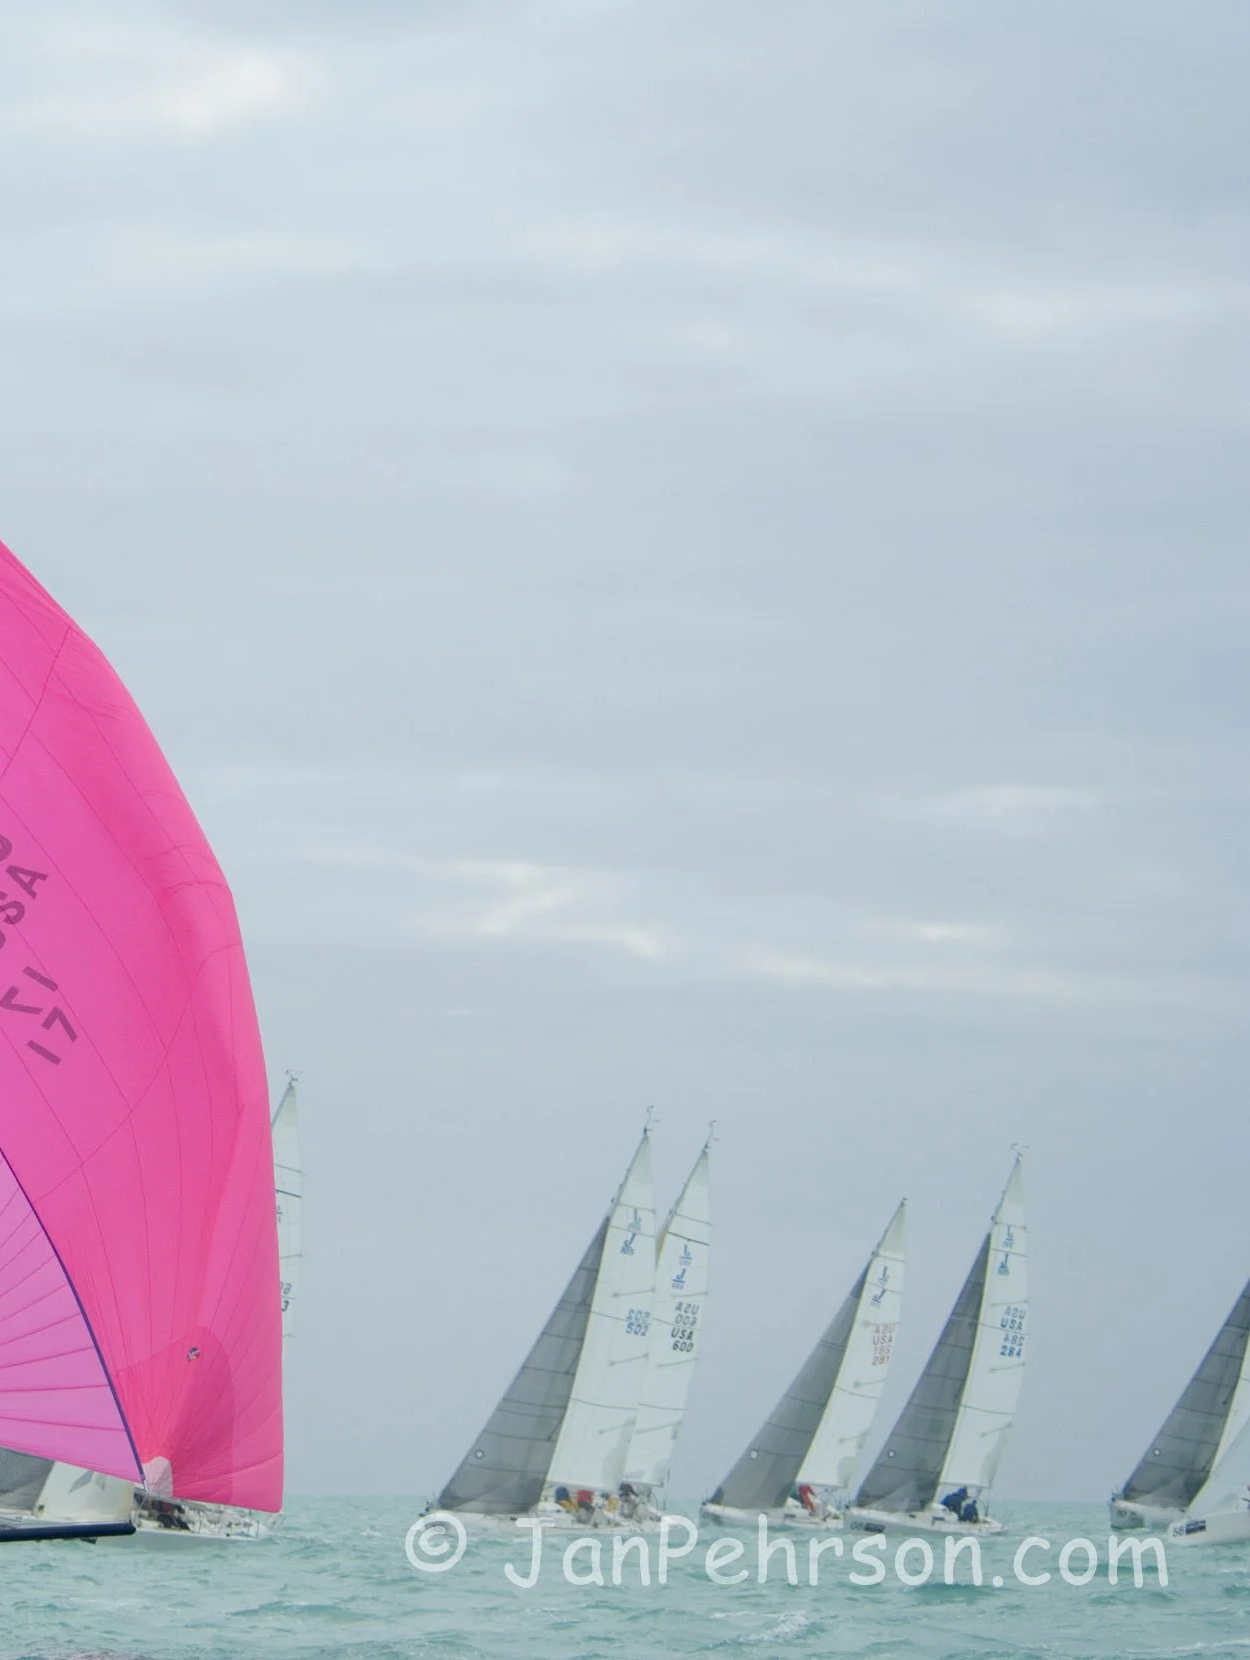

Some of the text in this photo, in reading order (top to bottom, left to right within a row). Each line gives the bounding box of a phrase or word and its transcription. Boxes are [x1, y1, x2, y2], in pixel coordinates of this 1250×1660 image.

[1000, 1317, 1023, 1331] USA
[670, 1326, 693, 1341] USA
[672, 1339, 695, 1353] 600
